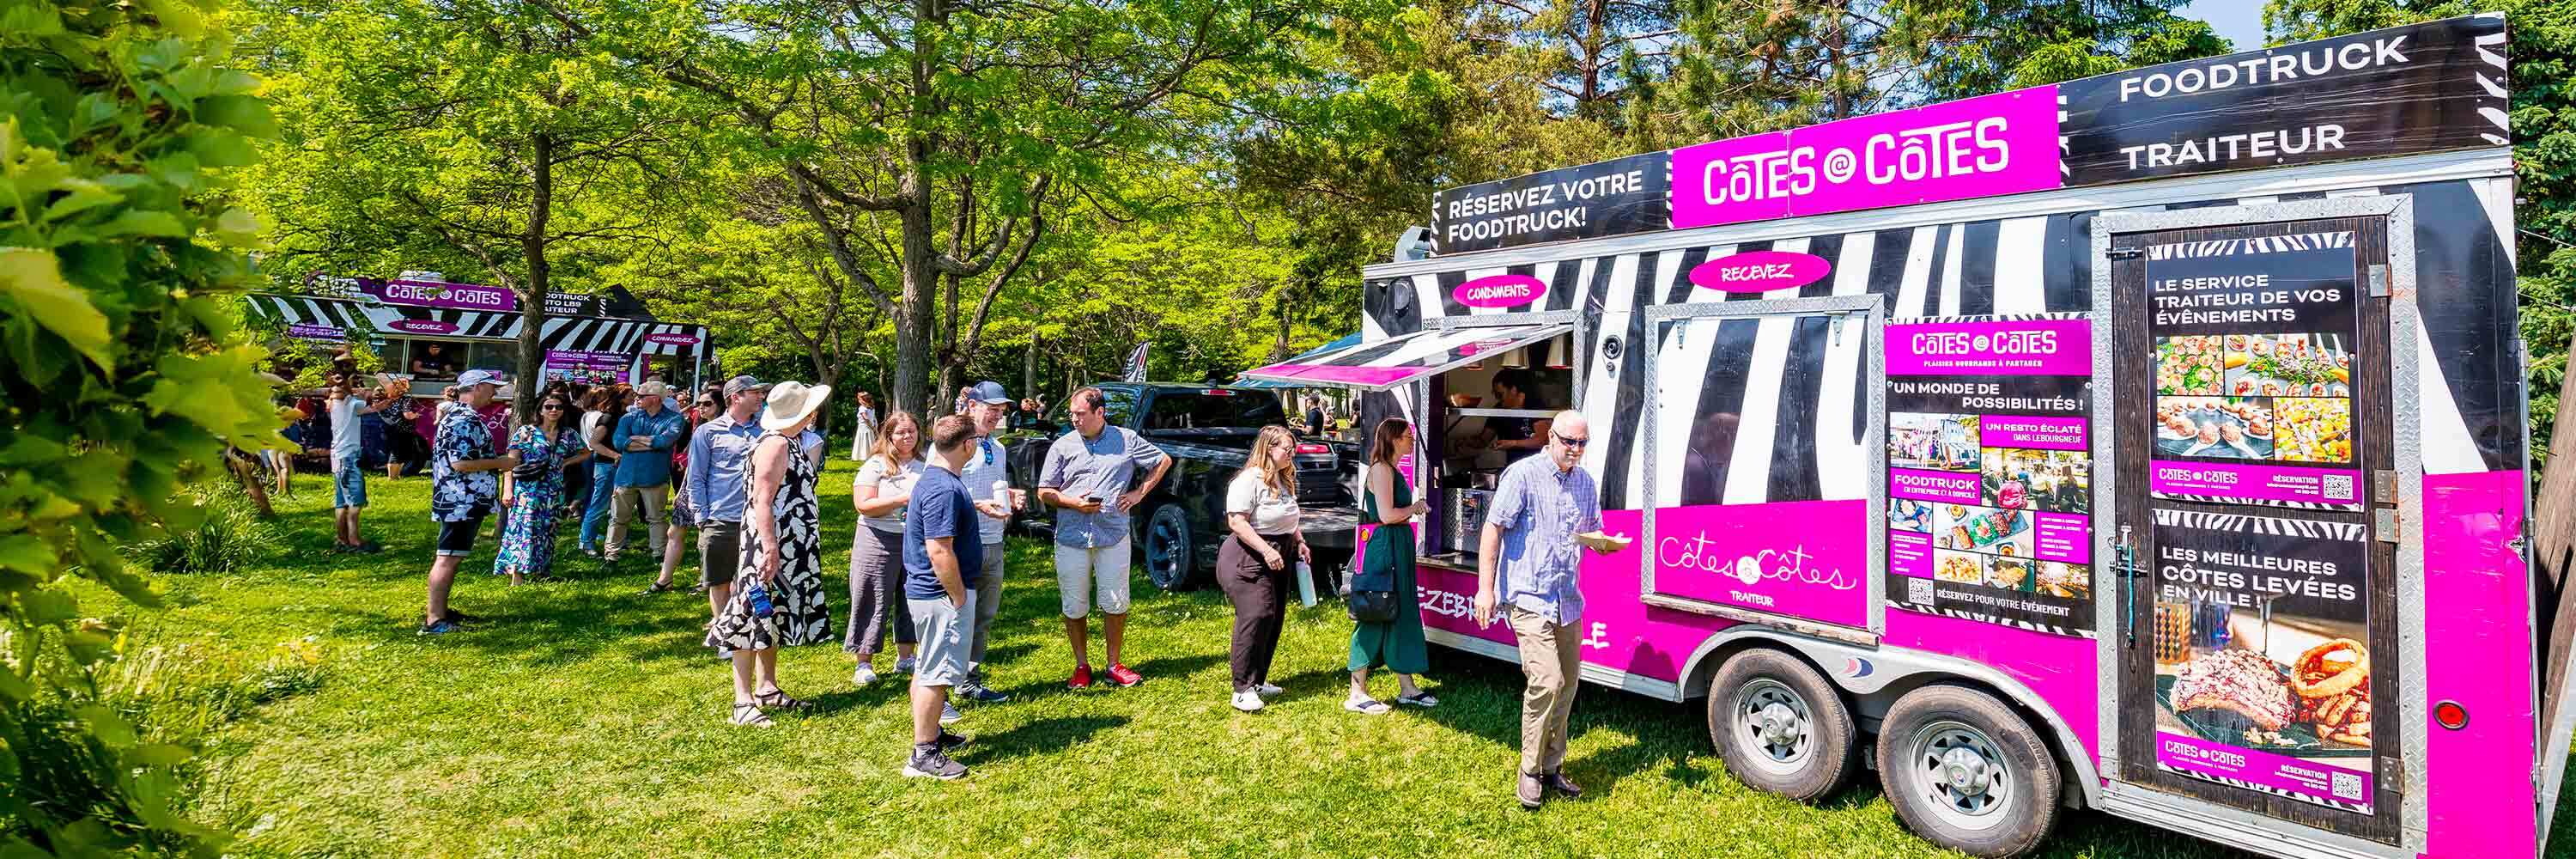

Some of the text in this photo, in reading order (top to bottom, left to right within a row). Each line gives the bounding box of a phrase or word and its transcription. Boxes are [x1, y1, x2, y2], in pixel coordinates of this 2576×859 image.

[2120, 35, 2410, 103] FOODTRUCK
[2120, 124, 2346, 171] TRAITEUR
[1449, 170, 1643, 219] RÉSERVEZ VOTRE
[1447, 206, 1587, 243] FOODTRUCK!
[1720, 263, 1795, 283] RECEVEZ
[1467, 283, 1531, 301] CONDIMENTS
[2155, 275, 2269, 292] LE SERVICE
[2155, 289, 2342, 308] TRAITEUR DE VOS
[1893, 382, 2000, 395] UN MONDE DE
[1963, 395, 2075, 411] POSSIBILITÉS
[2004, 423, 2038, 432] RESTO
[2041, 423, 2082, 434] ÉCLATÉ
[1895, 474, 1976, 490] FOODTRUCK
[2162, 546, 2336, 576] LES MEILLEURES
[2162, 563, 2356, 601] CÔTES LEVÉES
[1729, 590, 1774, 607] TRAITEUR
[1937, 588, 1974, 601] RÉSERVEZ
[1975, 594, 1995, 605] POUR
[1996, 598, 2020, 609] VOTRE
[2163, 584, 2189, 599] EN
[2194, 588, 2251, 608] VILLE
